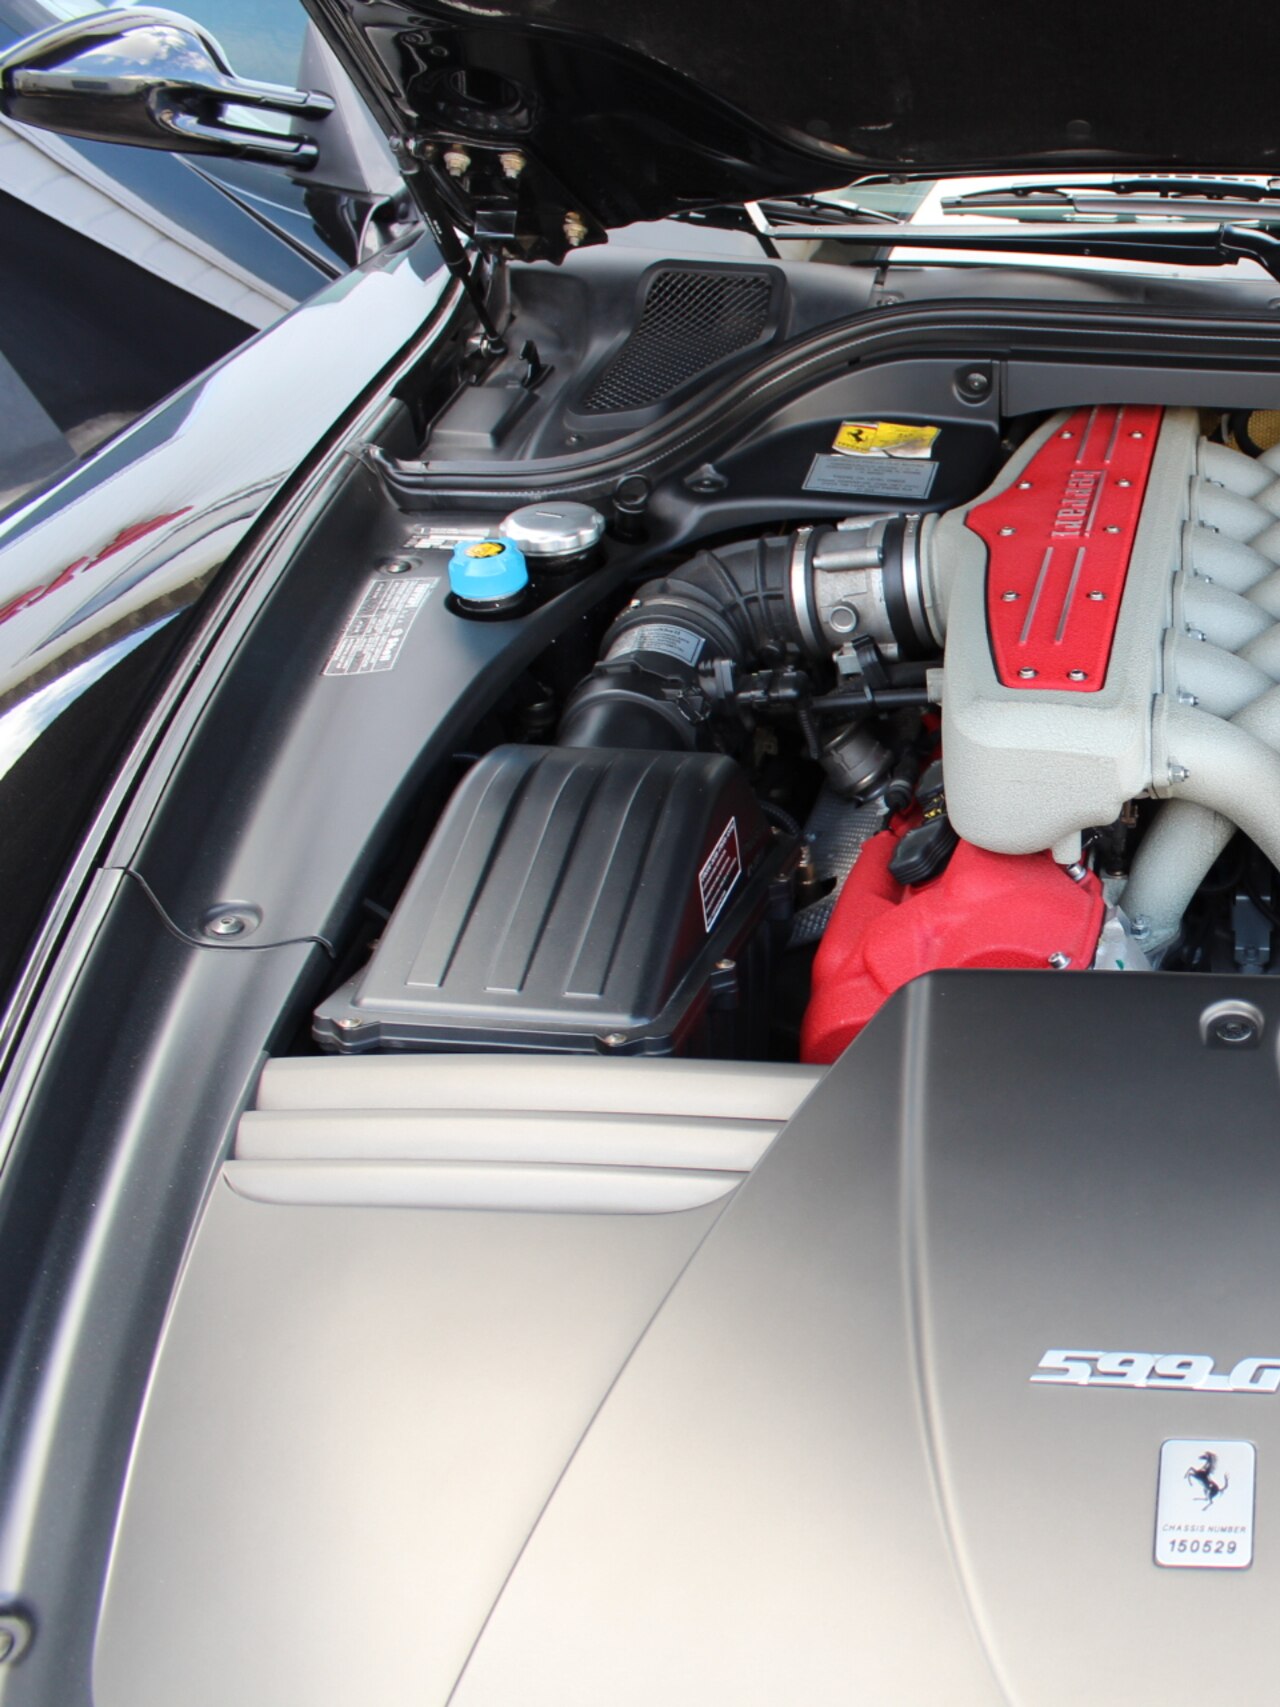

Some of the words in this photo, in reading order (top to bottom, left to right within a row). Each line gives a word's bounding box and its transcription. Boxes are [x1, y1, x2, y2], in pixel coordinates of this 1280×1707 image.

[1051, 470, 1107, 538] Ferrari
[1029, 1350, 1214, 1390] 599
[1162, 1523, 1206, 1533] CHASSIS
[1207, 1524, 1247, 1534] NUMBER
[1169, 1538, 1237, 1554] 150529
